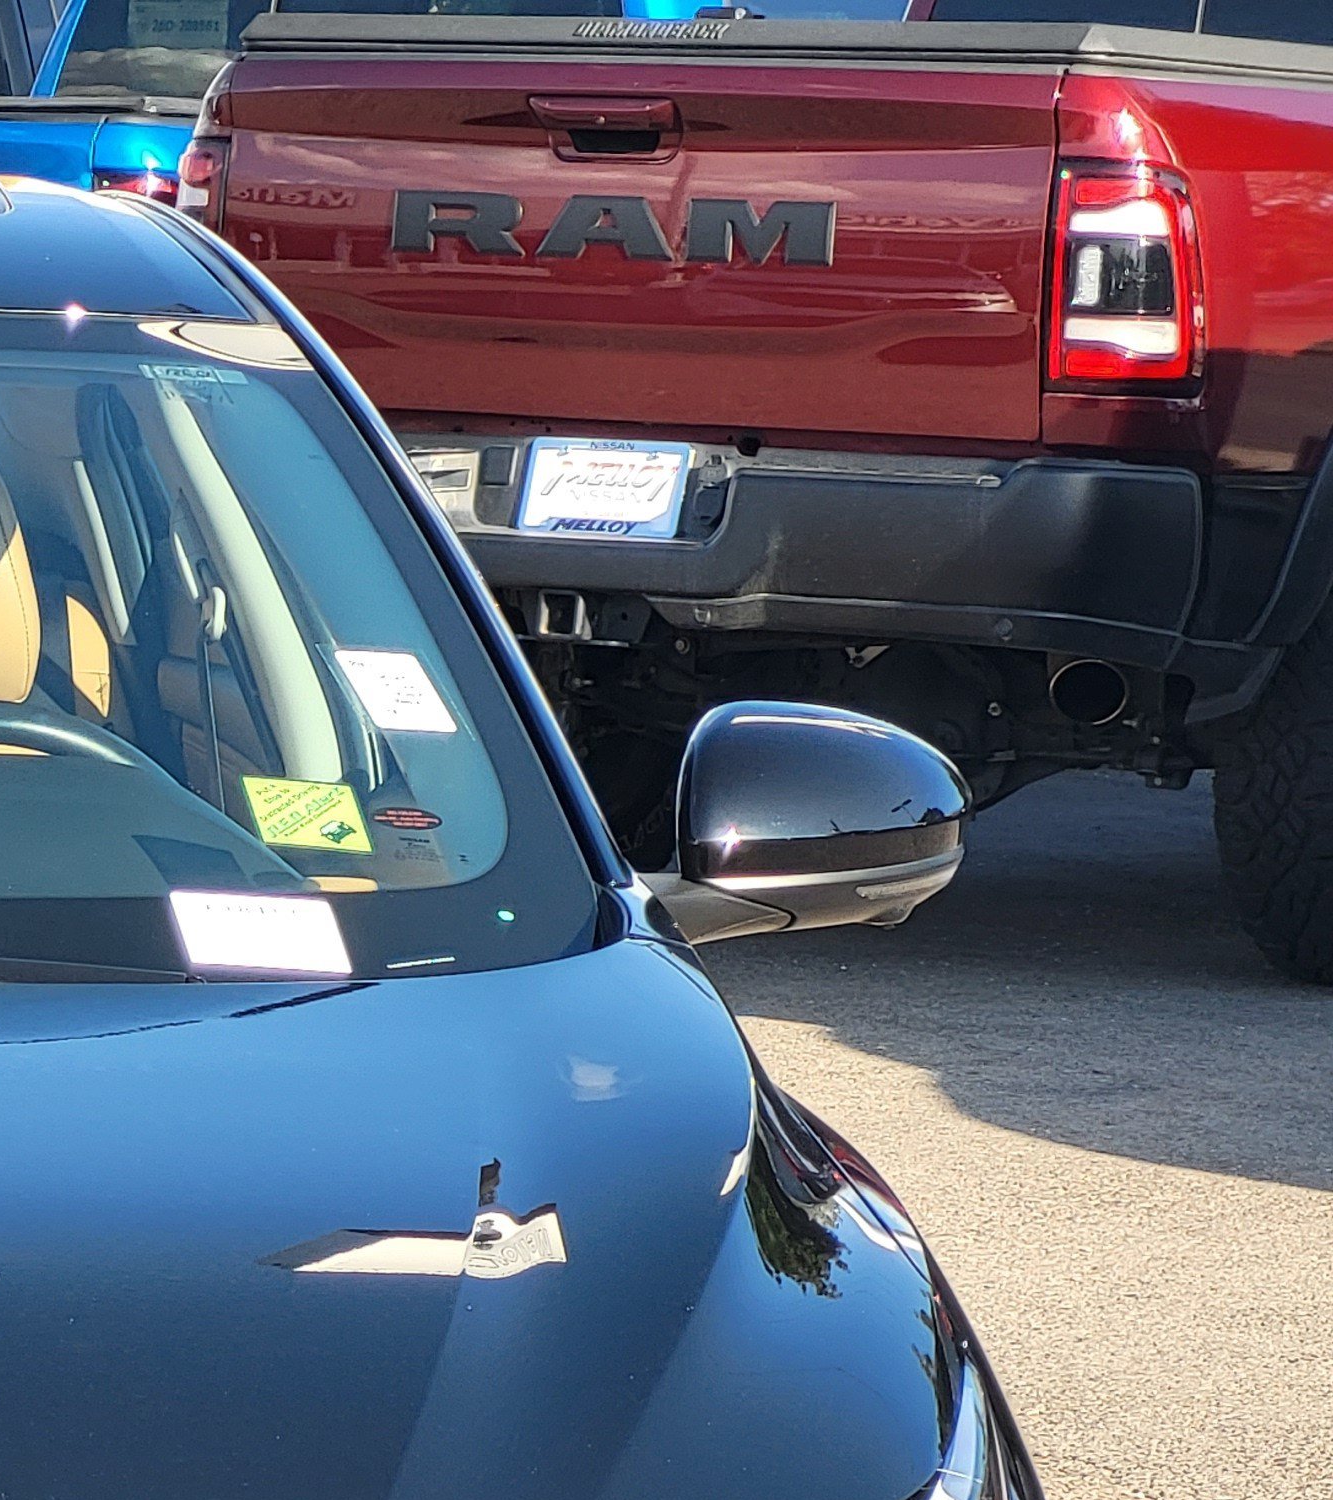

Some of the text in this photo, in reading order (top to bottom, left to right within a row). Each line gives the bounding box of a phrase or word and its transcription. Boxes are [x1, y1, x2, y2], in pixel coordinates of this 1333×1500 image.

[391, 189, 838, 266] RAM
[589, 441, 636, 451] NISSAN
[549, 518, 637, 535] MELLOY
